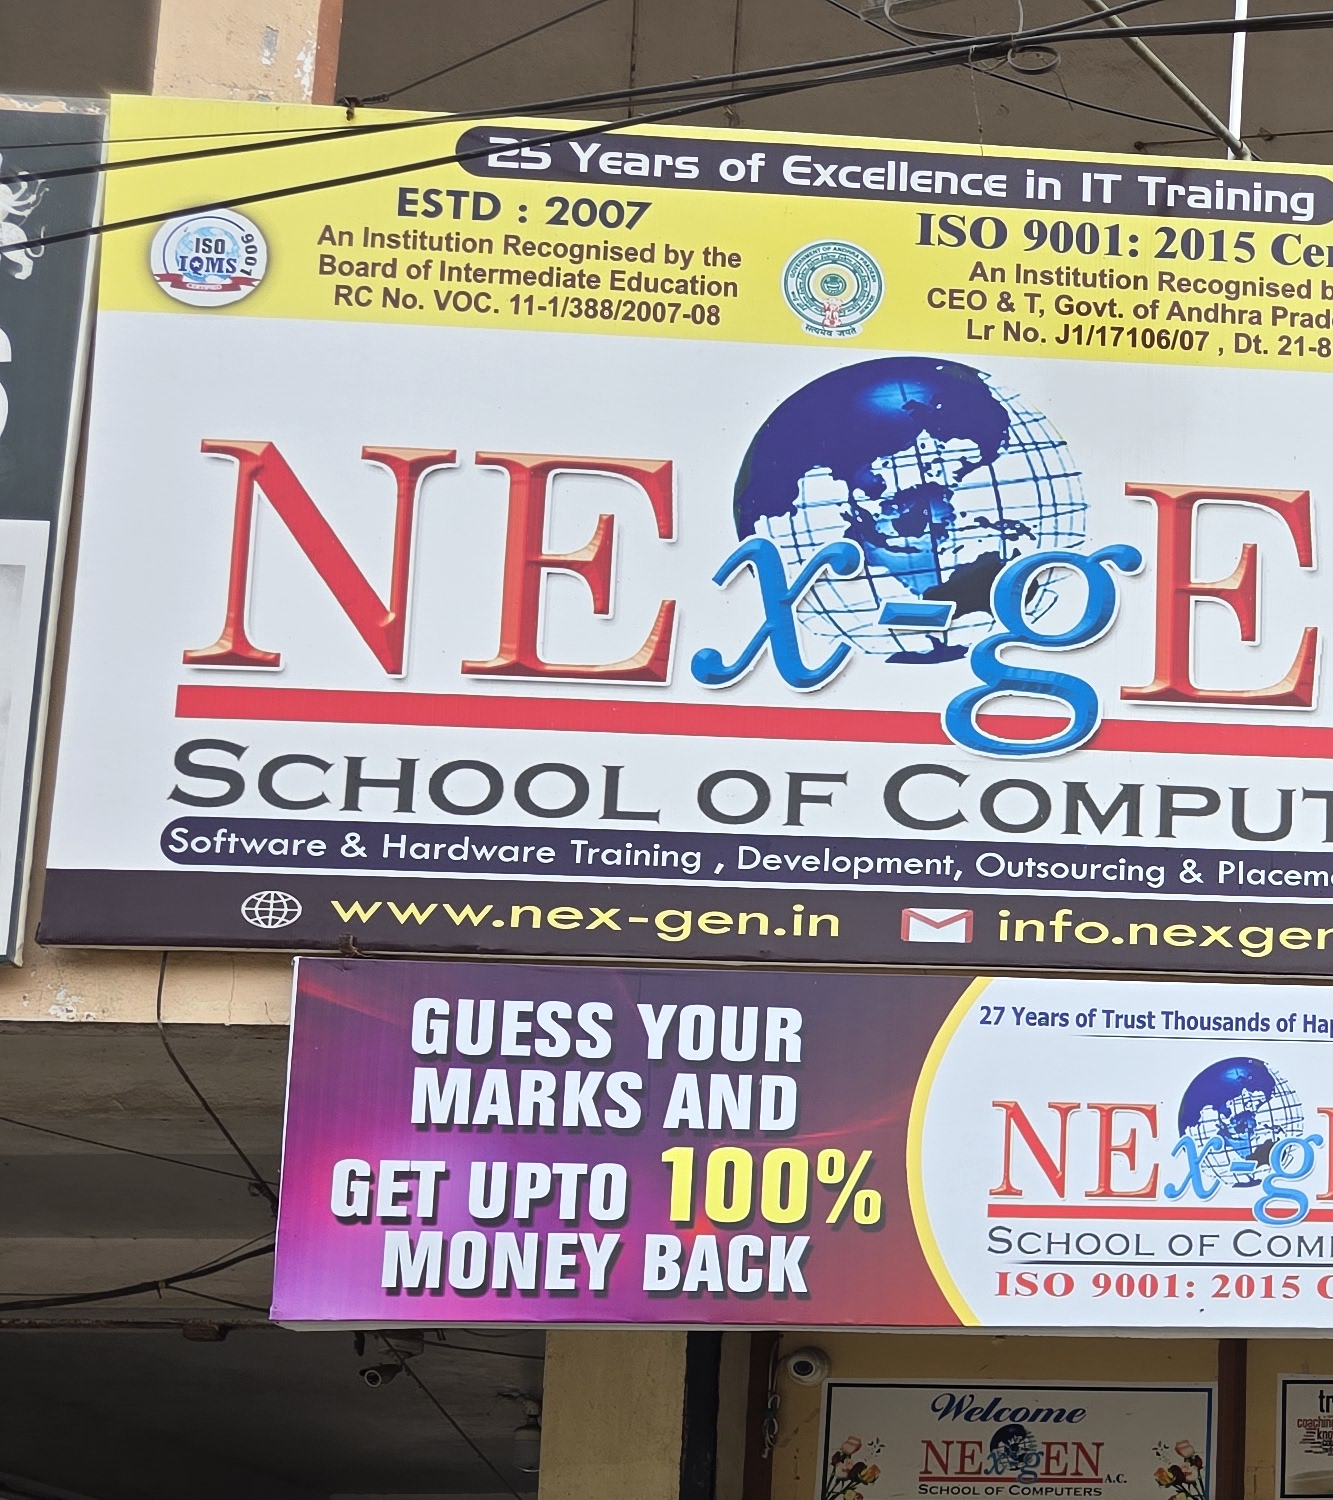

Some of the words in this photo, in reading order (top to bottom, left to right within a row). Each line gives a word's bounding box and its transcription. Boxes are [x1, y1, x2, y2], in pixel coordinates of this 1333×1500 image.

[487, 136, 551, 169] 25
[568, 140, 700, 183] Years
[719, 148, 764, 184] of
[783, 155, 1008, 199] Excellence
[1025, 167, 1062, 202] in
[1081, 173, 1124, 204] IT
[1138, 176, 1317, 221] Training
[398, 185, 501, 222] ESTD
[545, 196, 651, 232] 2007
[195, 238, 225, 254] ISO
[240, 234, 257, 276] 9001
[916, 214, 1008, 251] ISO
[1023, 222, 1140, 259] 9001:
[1154, 228, 1257, 263] 2015
[178, 256, 237, 275] IQMS
[169, 826, 327, 861] Software
[340, 831, 368, 860] &
[383, 835, 555, 865] Hardware
[570, 837, 702, 874] Training
[738, 843, 963, 881] Development,
[975, 851, 1165, 888] Outsourcing
[1180, 859, 1203, 884] &
[330, 897, 840, 940] www.nex-gen.in
[411, 998, 612, 1060] GUESS
[635, 1004, 803, 1063] YOUR
[980, 1005, 1005, 1025] 27
[1012, 1006, 1069, 1027] Years
[1076, 1008, 1097, 1028] of
[1102, 1010, 1155, 1029] Trust
[1161, 1010, 1270, 1033] Thousands
[1276, 1014, 1296, 1032] of
[411, 1068, 643, 1129] MARKS
[662, 1073, 798, 1131] AND
[330, 1159, 445, 1219] GET
[468, 1162, 627, 1222] UPTO
[661, 1146, 881, 1225] 100%
[380, 1231, 620, 1292] MONEY
[642, 1235, 809, 1295] BACK
[931, 1392, 1086, 1424] Welcome
